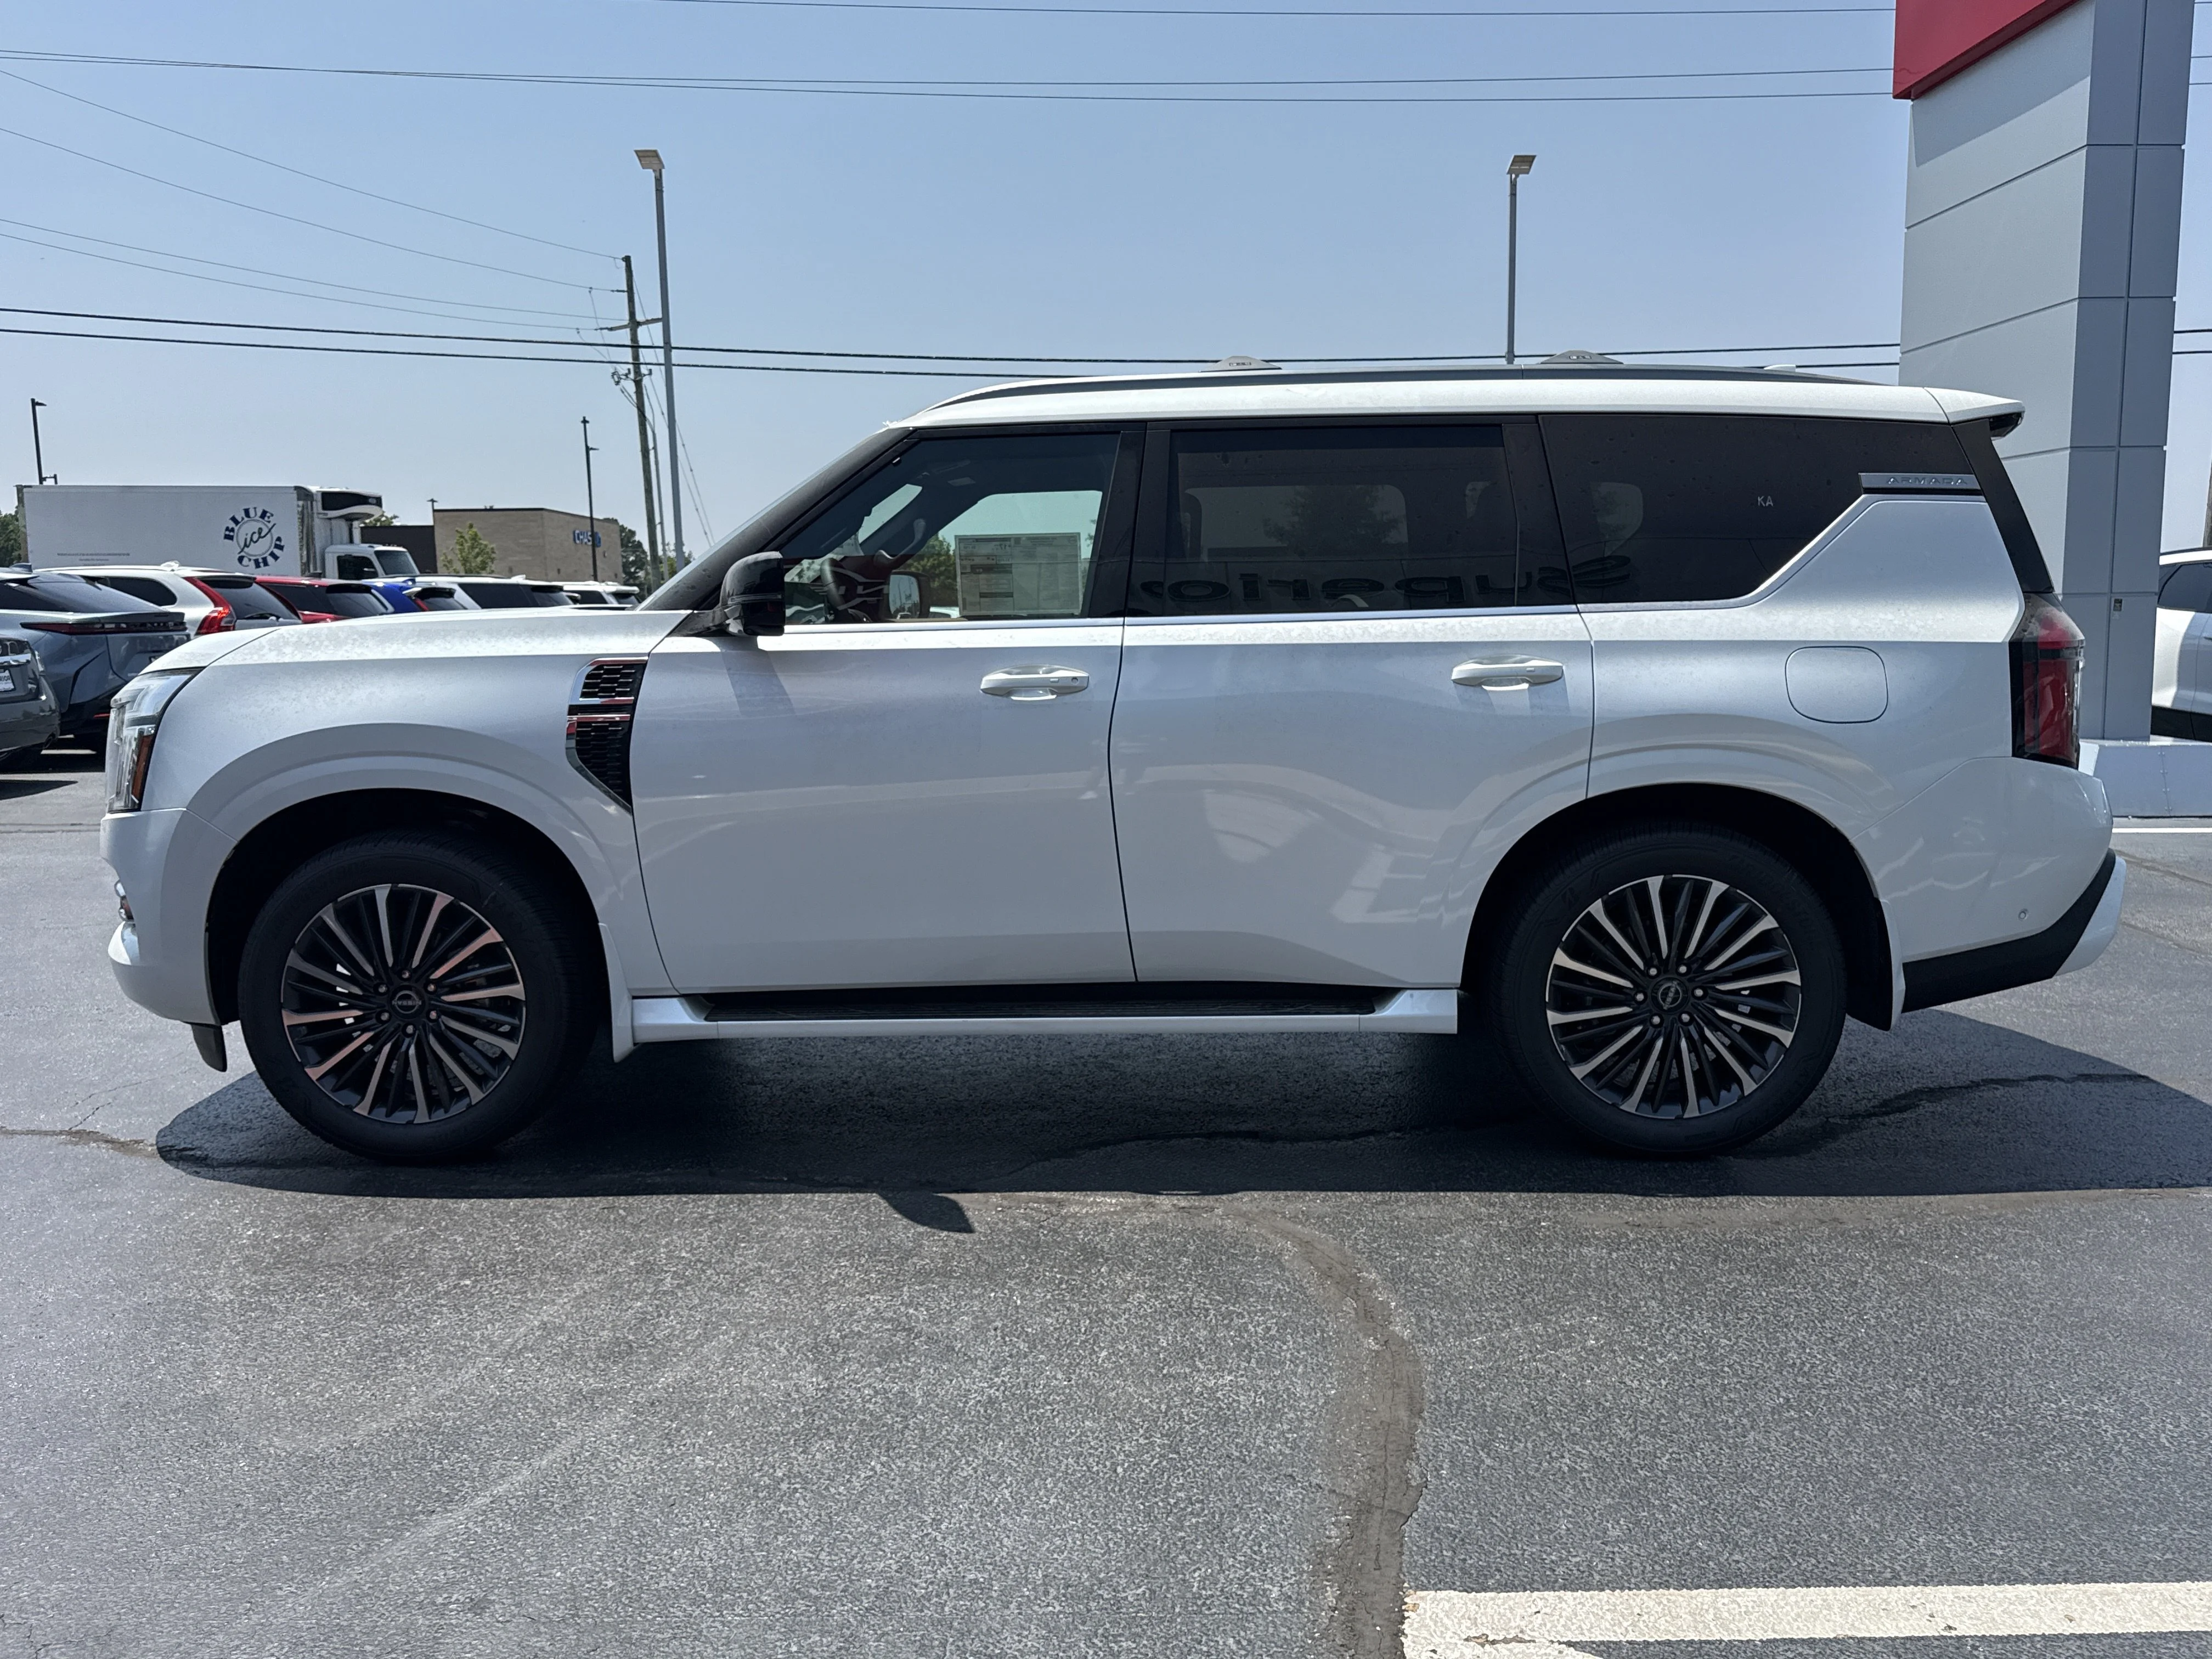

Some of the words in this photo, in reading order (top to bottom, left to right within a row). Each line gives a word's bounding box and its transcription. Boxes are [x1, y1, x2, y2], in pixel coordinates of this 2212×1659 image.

[1887, 477, 1967, 485] ARMADA
[1758, 496, 1773, 506] KA
[223, 507, 274, 542] BLUE
[238, 523, 276, 555] ice
[575, 530, 595, 545] CHAS
[237, 536, 285, 569] CHIP
